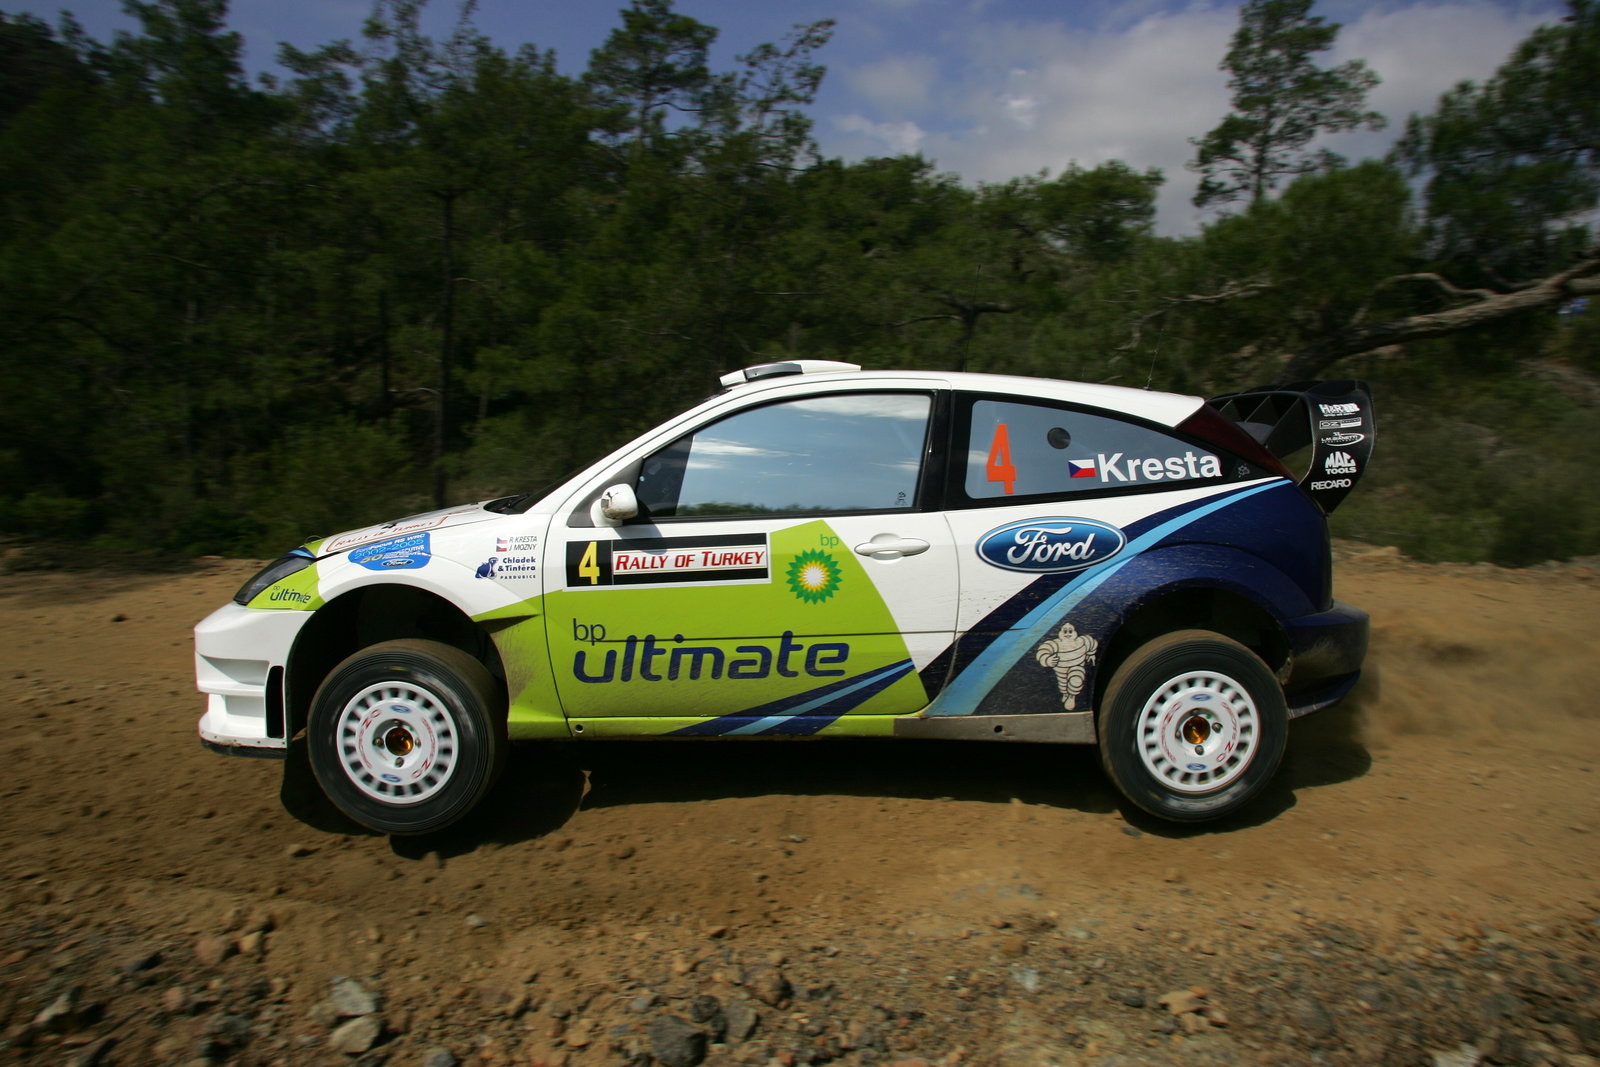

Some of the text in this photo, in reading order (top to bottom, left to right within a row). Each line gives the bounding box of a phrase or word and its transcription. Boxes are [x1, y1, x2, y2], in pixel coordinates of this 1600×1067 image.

[986, 424, 1017, 495] 4
[1097, 451, 1222, 483] Kresta
[1325, 451, 1356, 468] MAC
[1325, 467, 1357, 475] TOOLS
[1311, 479, 1352, 490] RECARO
[515, 535, 537, 543] KRESTA
[820, 534, 840, 549] bp
[1006, 526, 1096, 564] Ford
[578, 541, 601, 585] 4
[615, 550, 765, 571] RALLY OF TURKEY
[572, 618, 607, 645] bp
[573, 630, 850, 684] ultimate
